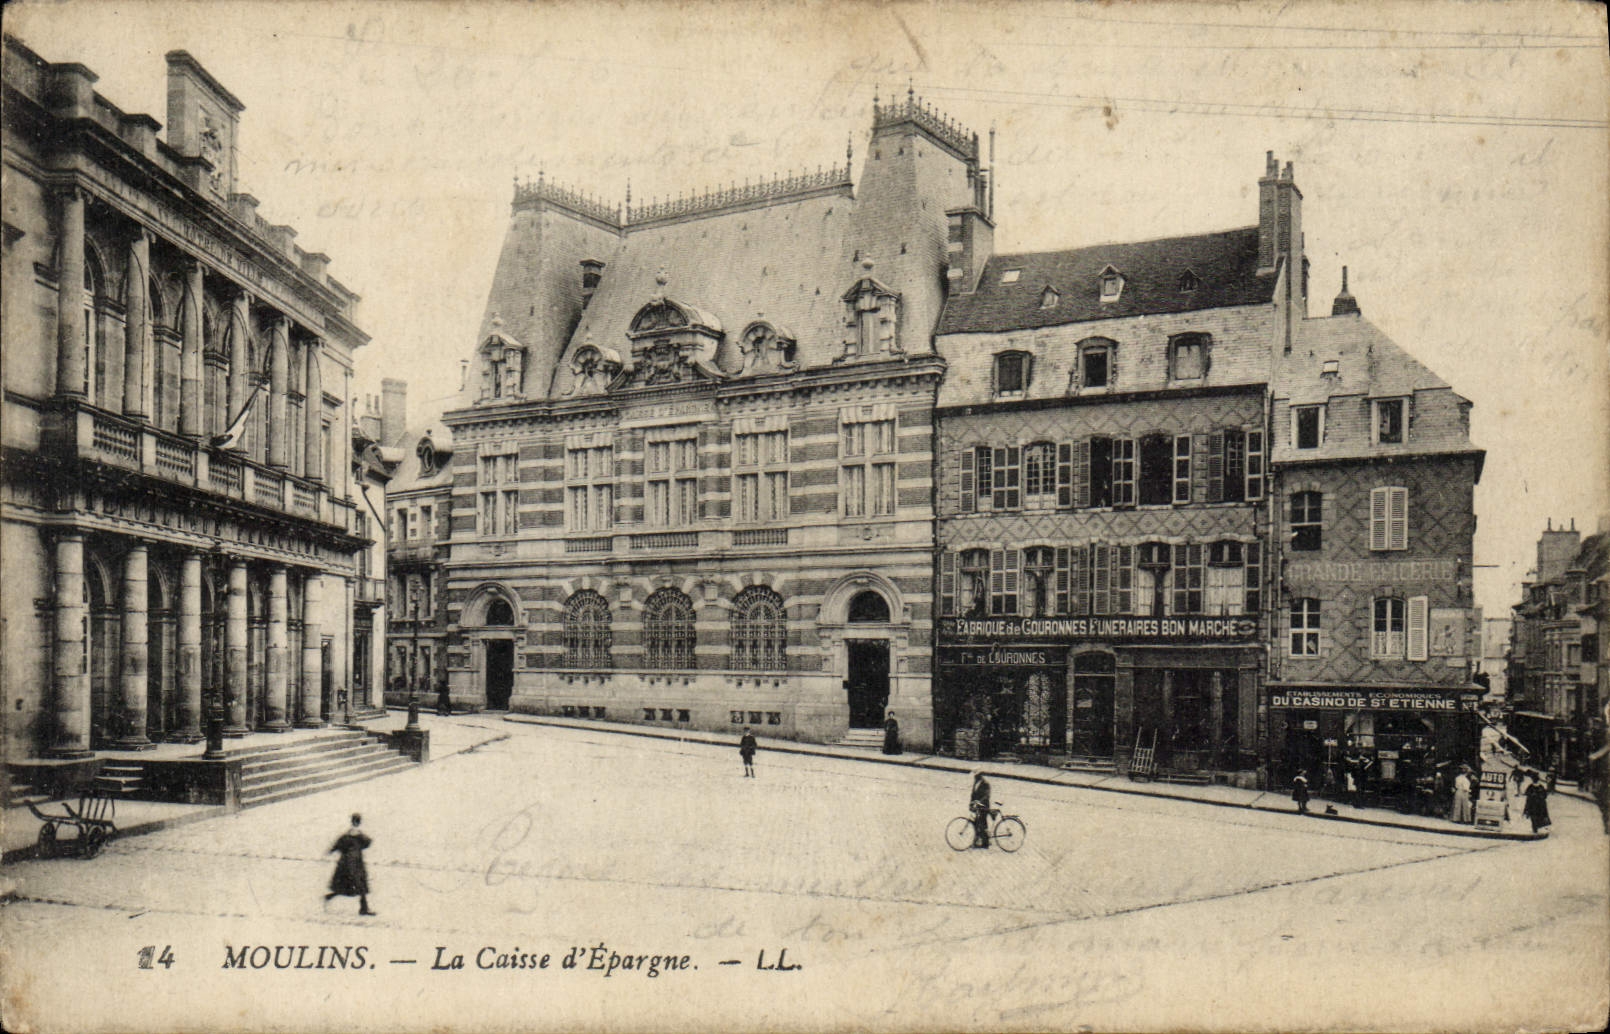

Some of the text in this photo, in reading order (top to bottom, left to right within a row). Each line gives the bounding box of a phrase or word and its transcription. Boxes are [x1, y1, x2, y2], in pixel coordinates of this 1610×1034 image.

[1288, 561, 1362, 582] GRANDE
[957, 618, 1005, 636] FABRIQUE
[1022, 618, 1086, 635] COURONNES
[1161, 619, 1185, 635] BON
[1272, 696, 1289, 706] DU
[1292, 697, 1344, 707] CASINO
[1347, 698, 1366, 707] DE
[1389, 699, 1456, 709] ETIENNE
